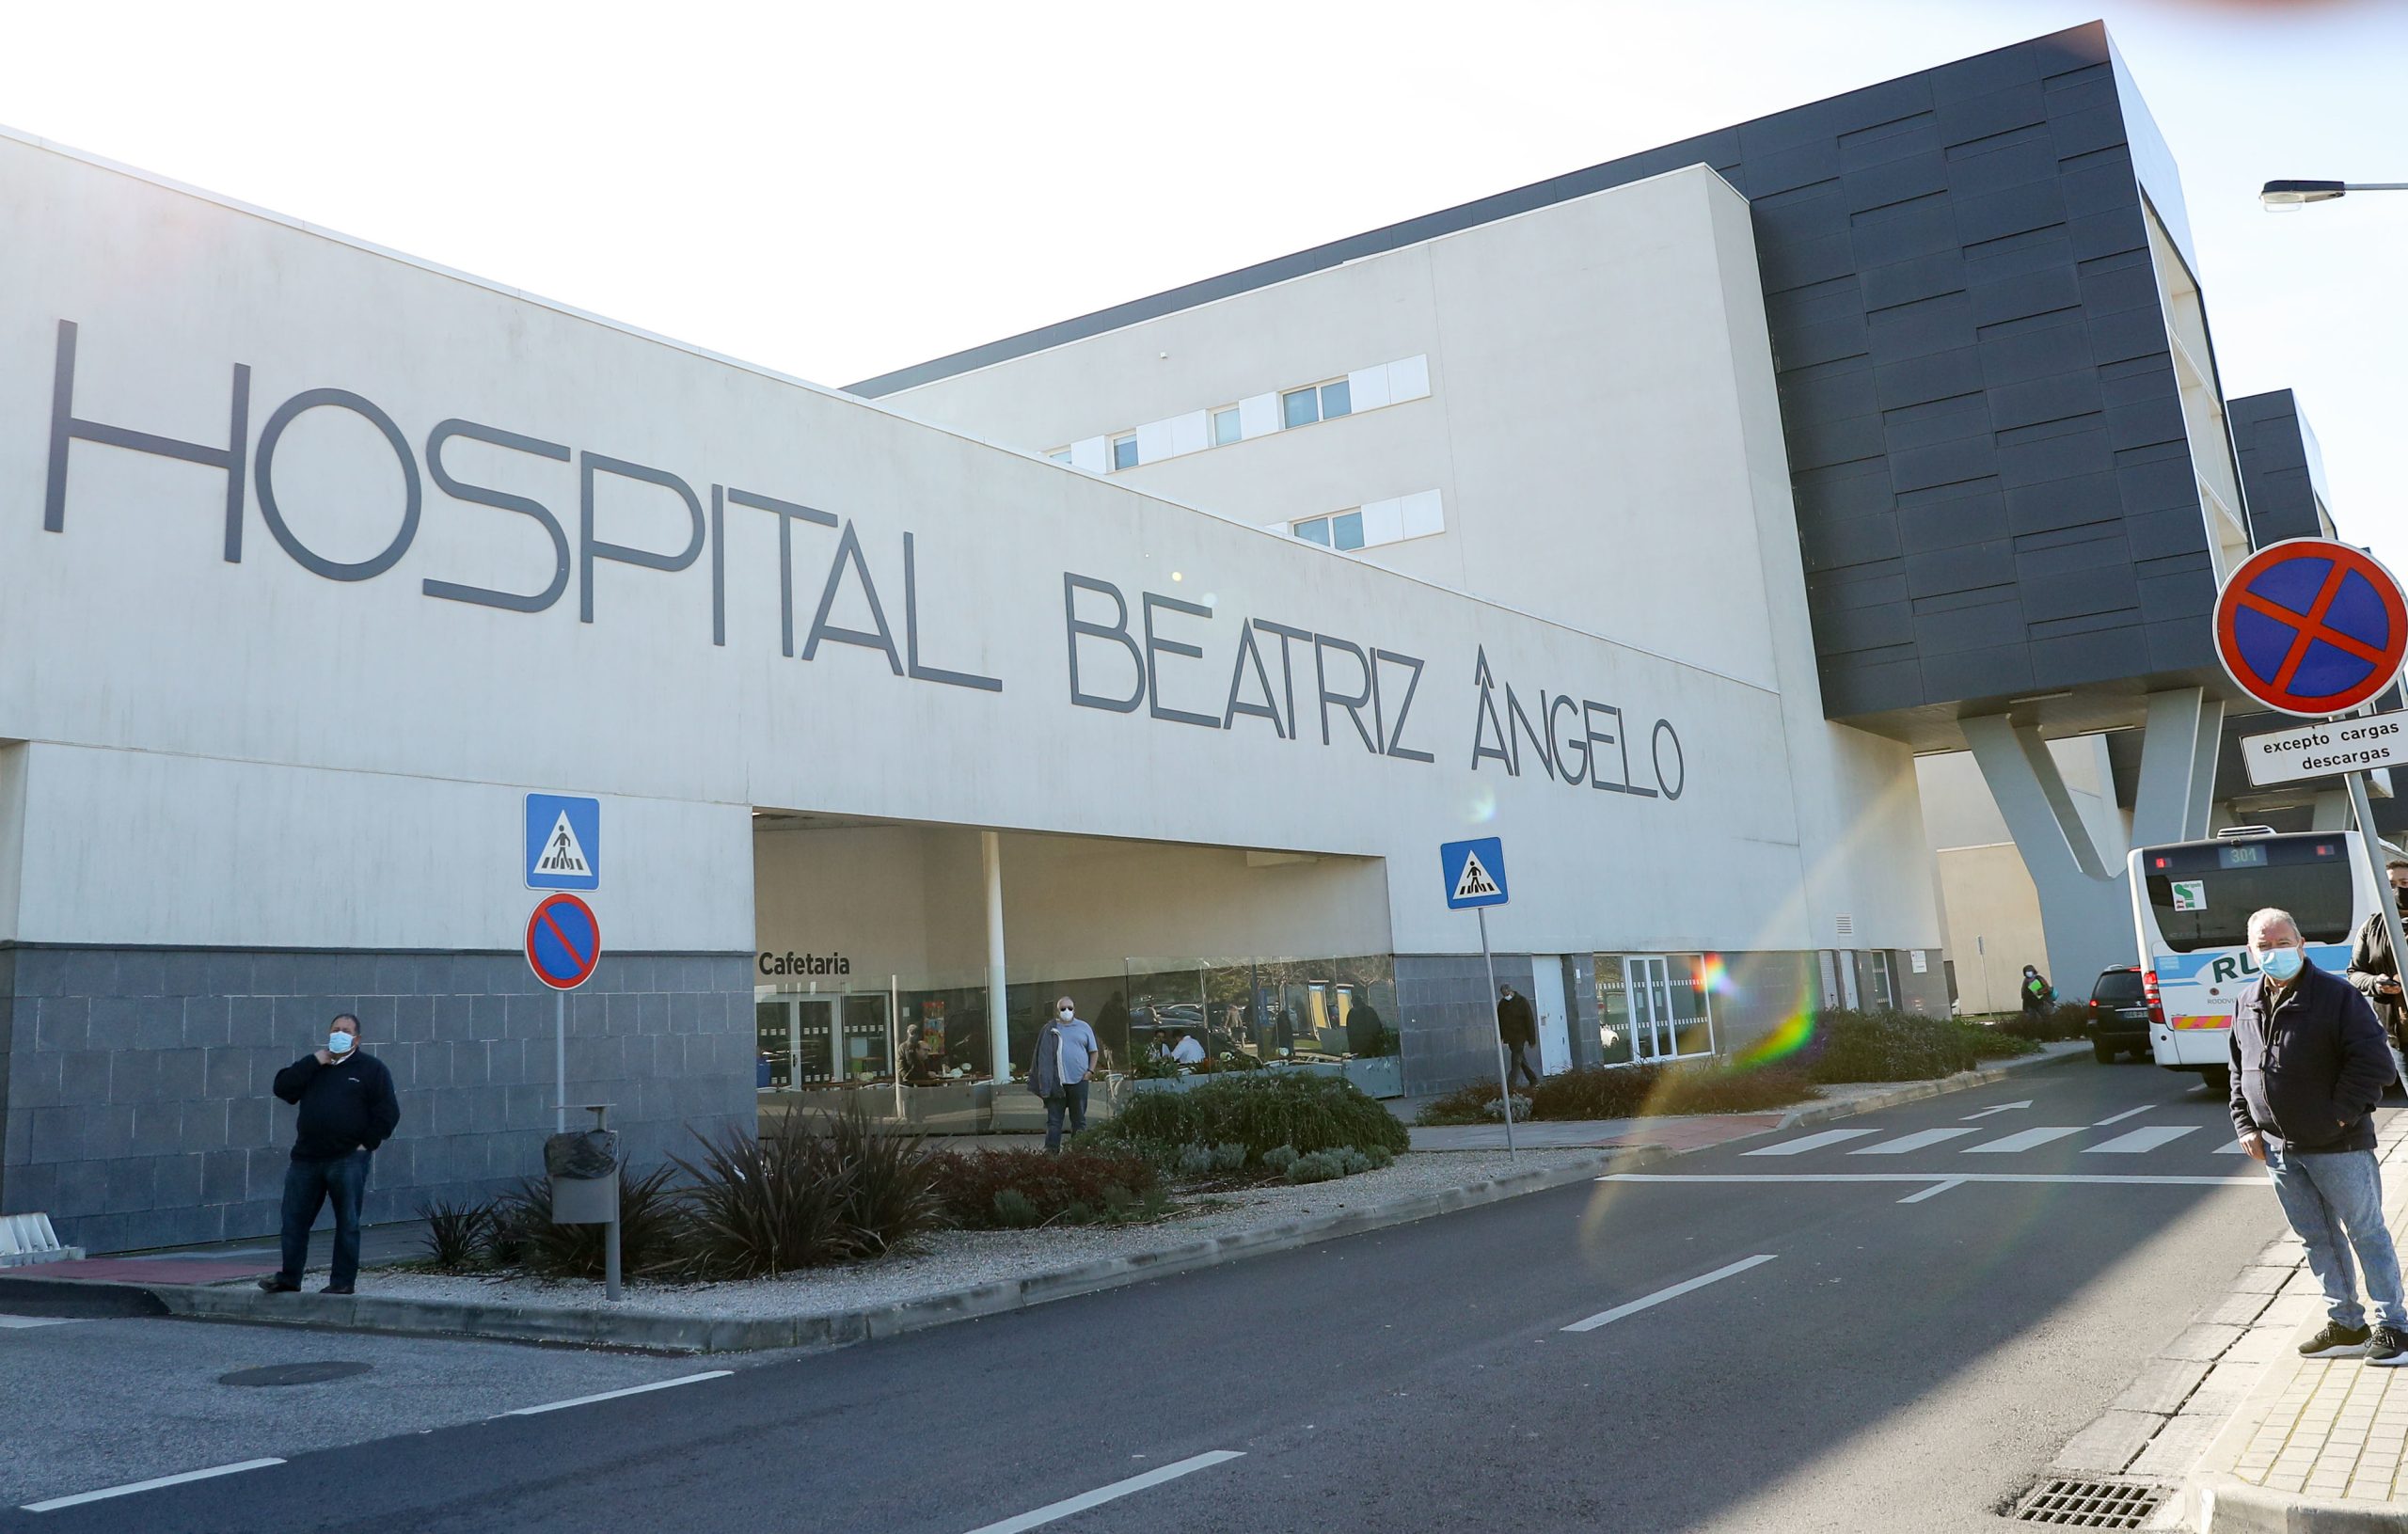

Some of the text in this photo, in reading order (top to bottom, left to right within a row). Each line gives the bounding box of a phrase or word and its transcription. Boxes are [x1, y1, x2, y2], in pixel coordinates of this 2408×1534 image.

[44, 318, 1685, 801] HOSPITAL BEATRIZ ÂNGELO
[2263, 722, 2400, 753] excepto cargas
[2302, 747, 2390, 770] descargas
[2230, 847, 2257, 863] 301
[758, 952, 850, 975] Cafetaria
